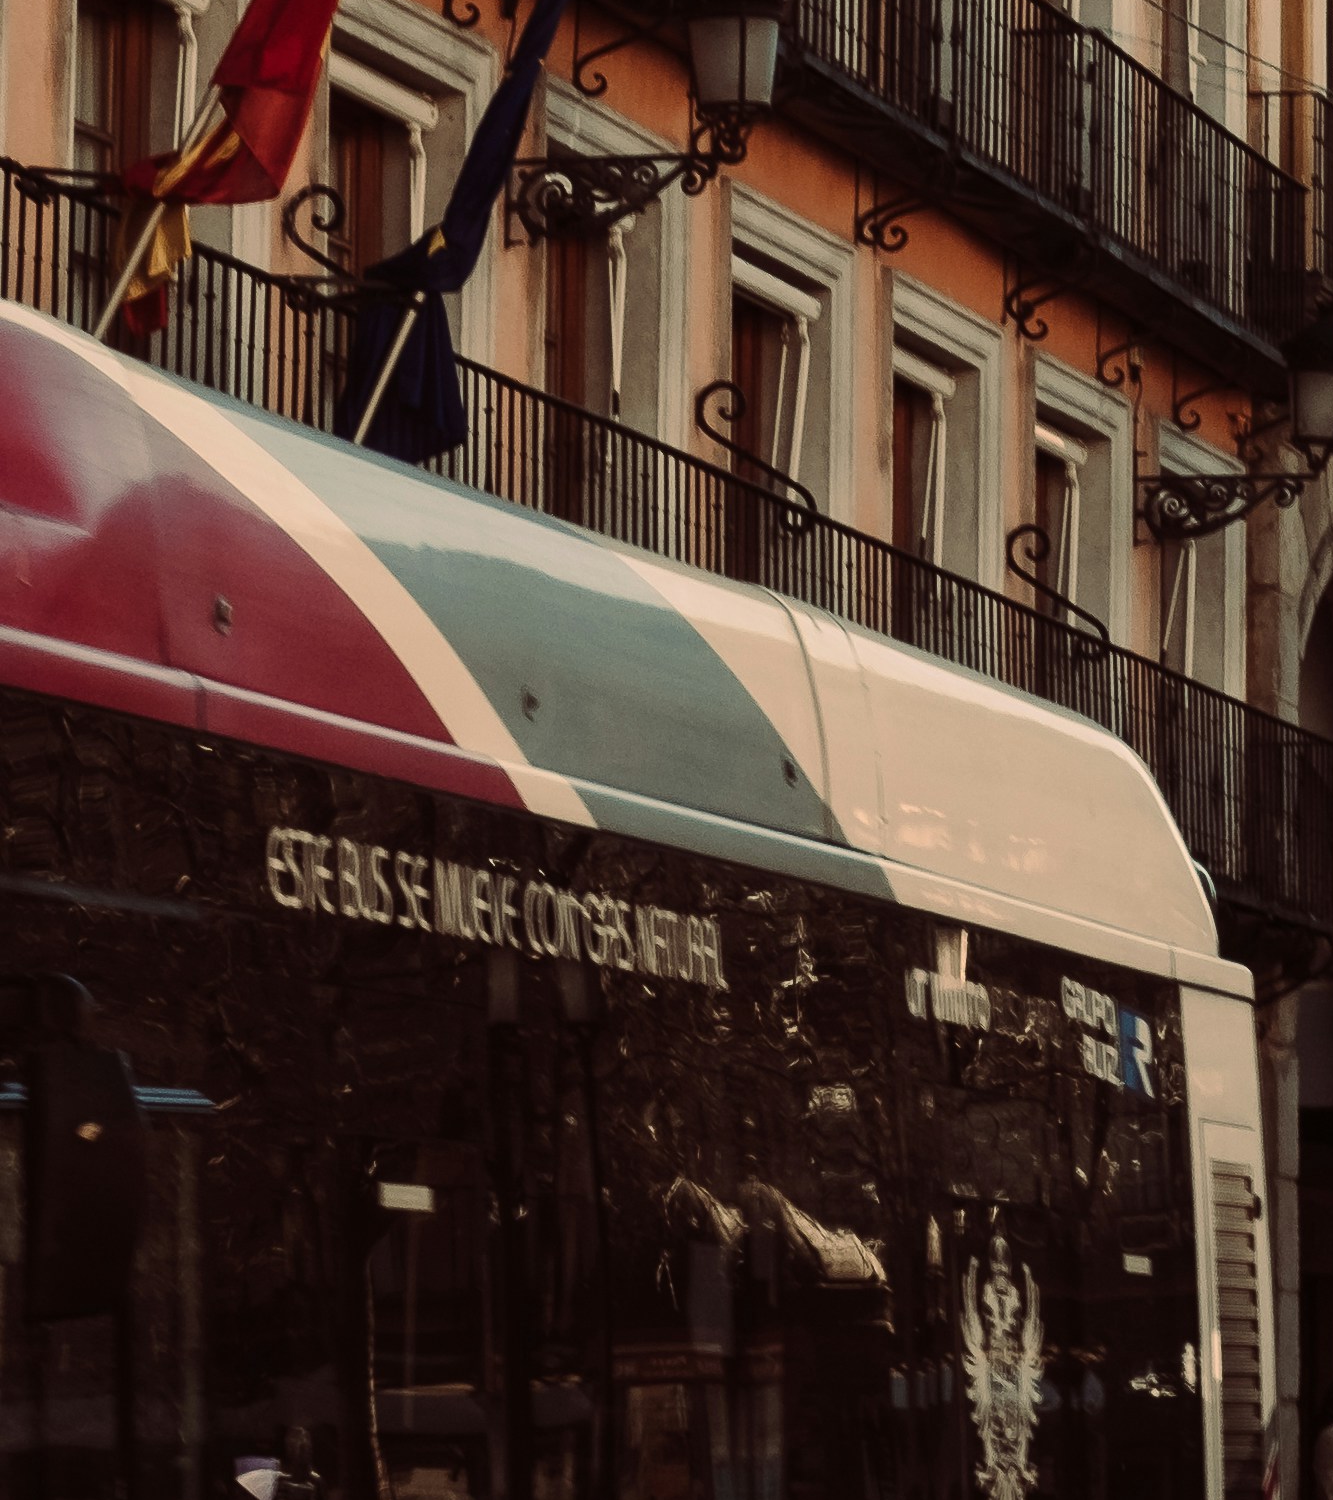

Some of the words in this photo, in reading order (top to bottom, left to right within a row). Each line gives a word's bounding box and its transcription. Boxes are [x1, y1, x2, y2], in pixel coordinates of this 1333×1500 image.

[266, 826, 336, 914] ESTE
[338, 837, 393, 925] BUS
[396, 850, 432, 932] SE
